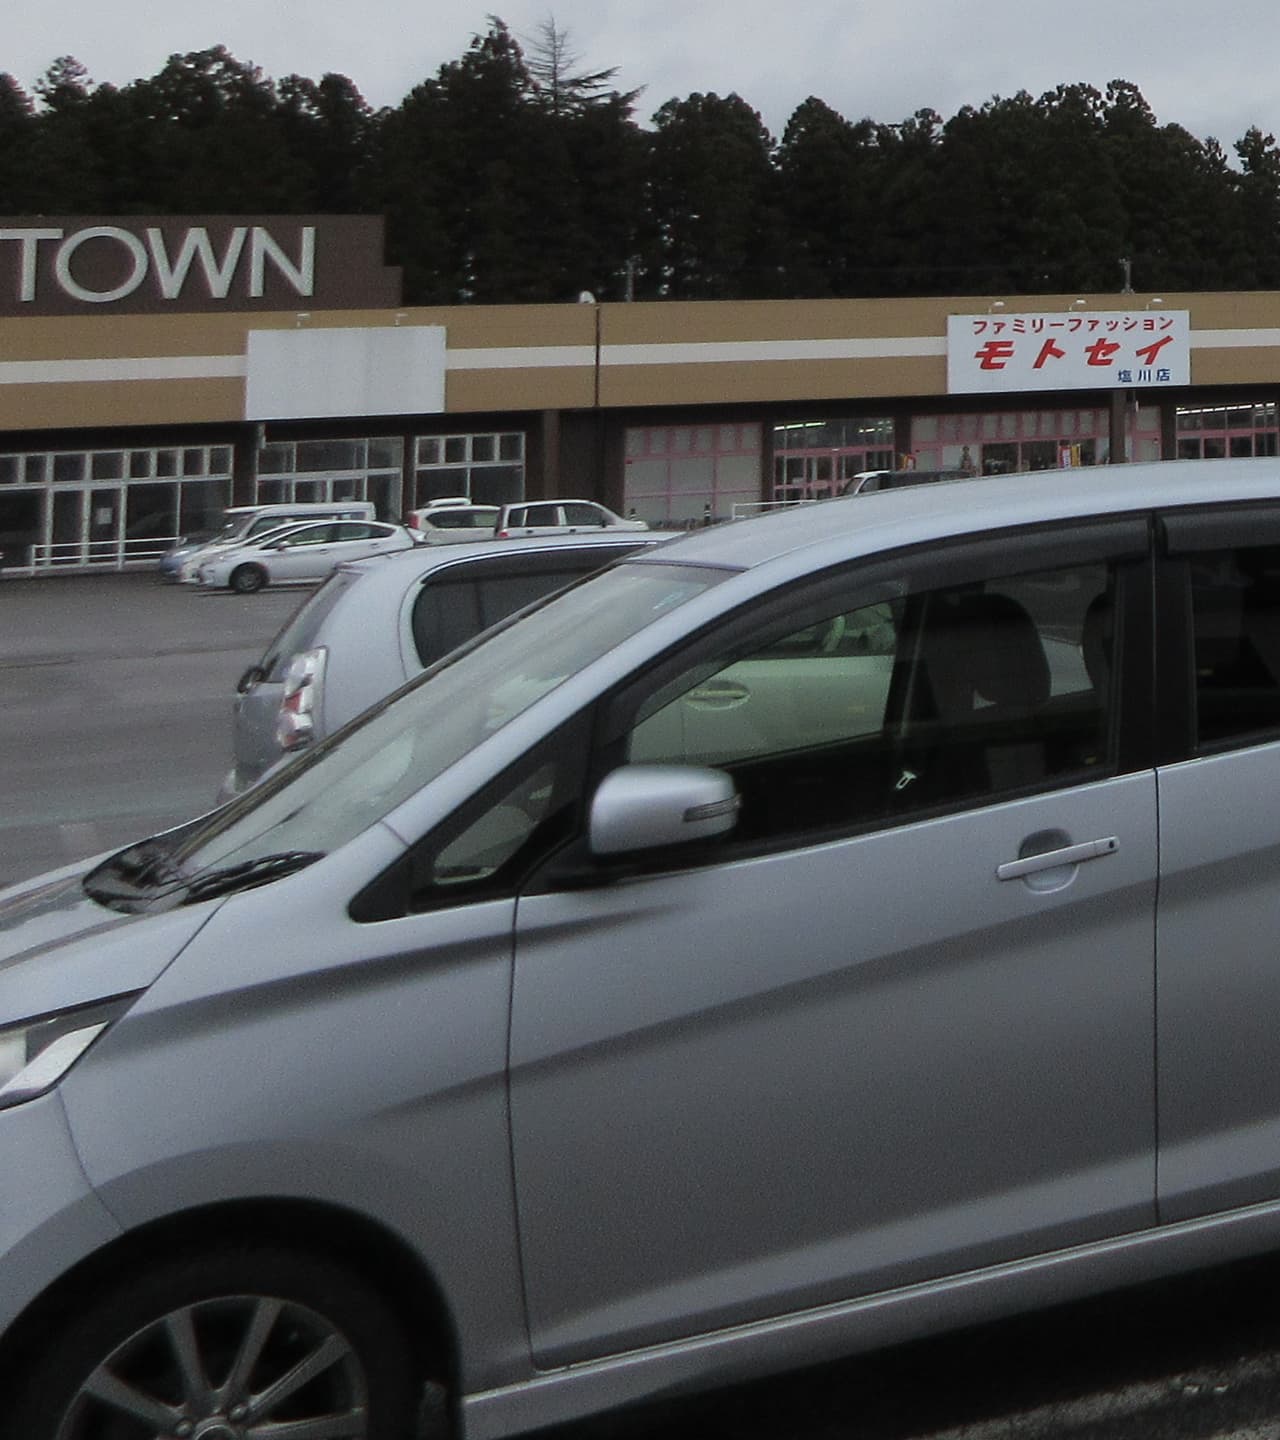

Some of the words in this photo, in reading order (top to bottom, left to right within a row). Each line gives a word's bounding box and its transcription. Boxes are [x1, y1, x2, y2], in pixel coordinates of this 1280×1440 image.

[0, 226, 316, 302] TOWN
[972, 316, 1174, 335] ファミリーファッション
[974, 335, 1174, 370] モトセイ
[1118, 368, 1171, 383] 塩川店
